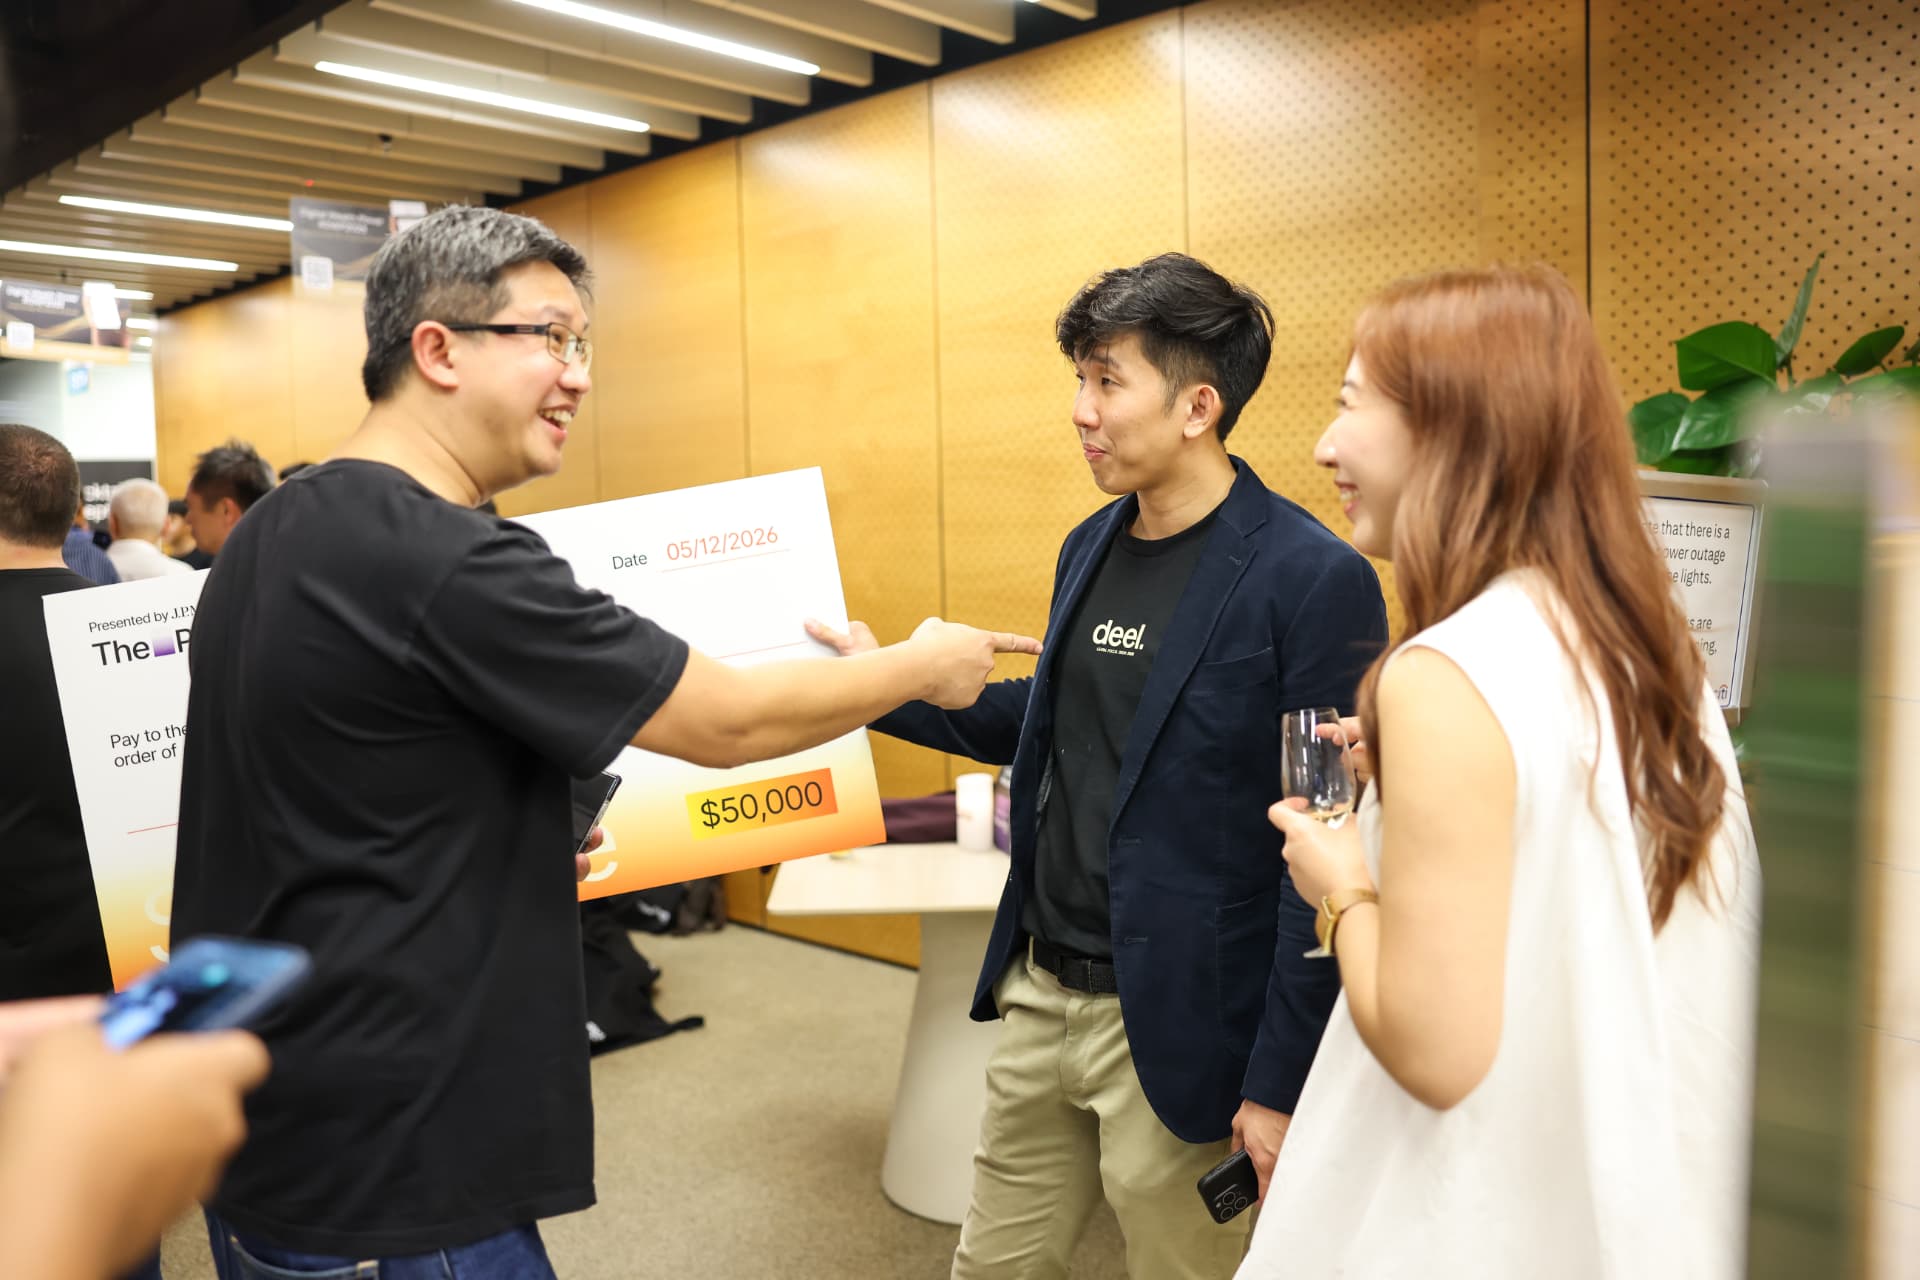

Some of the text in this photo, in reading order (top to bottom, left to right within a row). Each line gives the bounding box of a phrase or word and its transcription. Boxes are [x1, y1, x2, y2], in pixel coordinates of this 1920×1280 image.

[1661, 520, 1683, 536] that
[1685, 522, 1712, 538] there
[1714, 523, 1722, 538] is
[1723, 528, 1730, 539] a
[612, 526, 779, 570] Date 05/12/2026
[1690, 549, 1726, 565] outage
[1680, 568, 1712, 586] lights.
[89, 613, 151, 632] Presented
[153, 612, 169, 623] by
[1696, 618, 1712, 630] are
[1092, 619, 1146, 650] deel.
[91, 640, 150, 666] The
[110, 733, 140, 749] Pay
[144, 729, 161, 743] to
[114, 742, 177, 768] order of
[701, 781, 823, 829] $50,000
